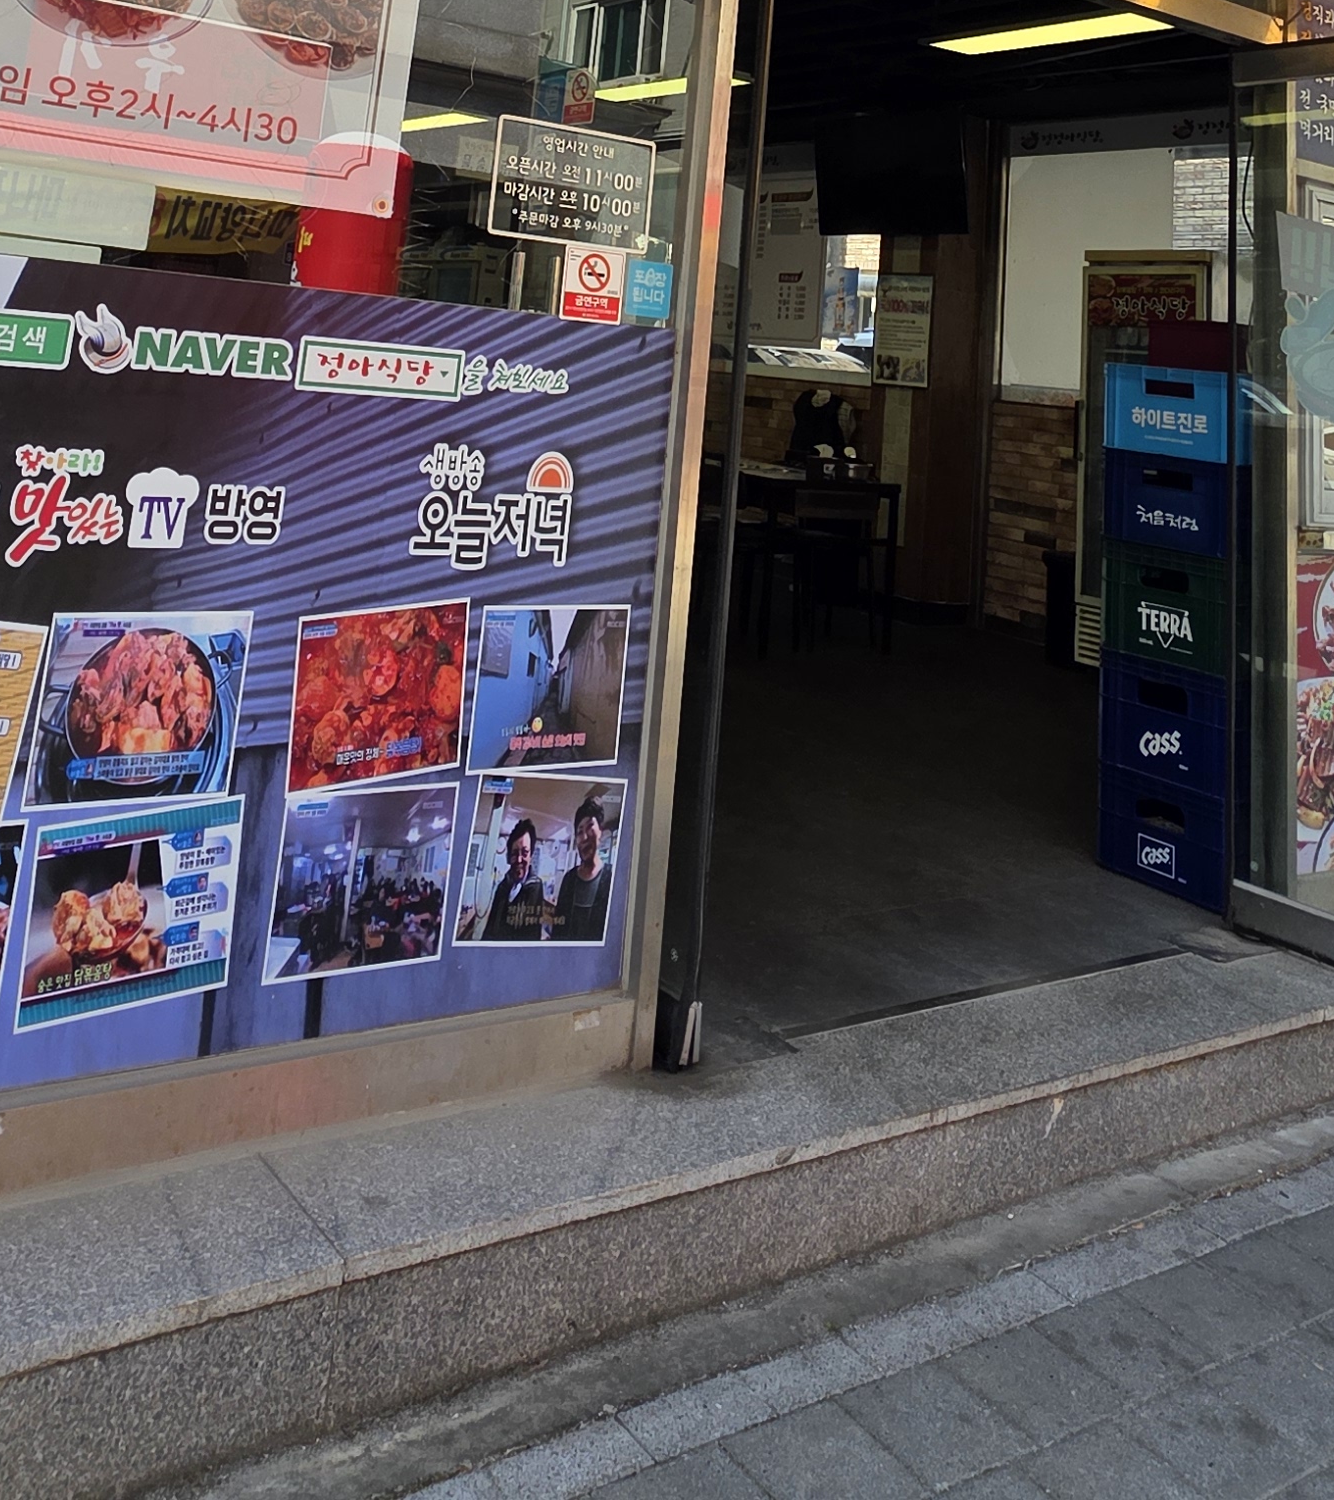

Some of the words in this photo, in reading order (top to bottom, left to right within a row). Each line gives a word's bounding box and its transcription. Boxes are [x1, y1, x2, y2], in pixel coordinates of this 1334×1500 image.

[41, 73, 299, 147] 오후2시~4시30
[542, 135, 588, 157] 영업시간
[592, 143, 615, 160] 안내
[505, 155, 557, 180] 오픈시간
[562, 163, 581, 179] 오전
[503, 181, 556, 205] 마감시간
[559, 189, 578, 205] 오후
[517, 209, 560, 229] 주문마감
[561, 215, 581, 231] 오후
[574, 295, 609, 309] 금연구역
[631, 287, 665, 304] 됩니다
[1112, 295, 1192, 320] 정아식당
[134, 330, 292, 377] NAVER
[316, 351, 436, 385] 정아식당
[1131, 406, 1209, 435] 하이트진로
[19, 447, 104, 474] 찾아라!
[421, 446, 486, 490] 생방송
[138, 495, 186, 540] TV
[208, 487, 284, 541] 방영
[1135, 504, 1200, 532] 처음처럼
[410, 492, 573, 569] 오늘저녁
[1137, 605, 1194, 642] TERRA
[37, 978, 54, 994] 숨은
